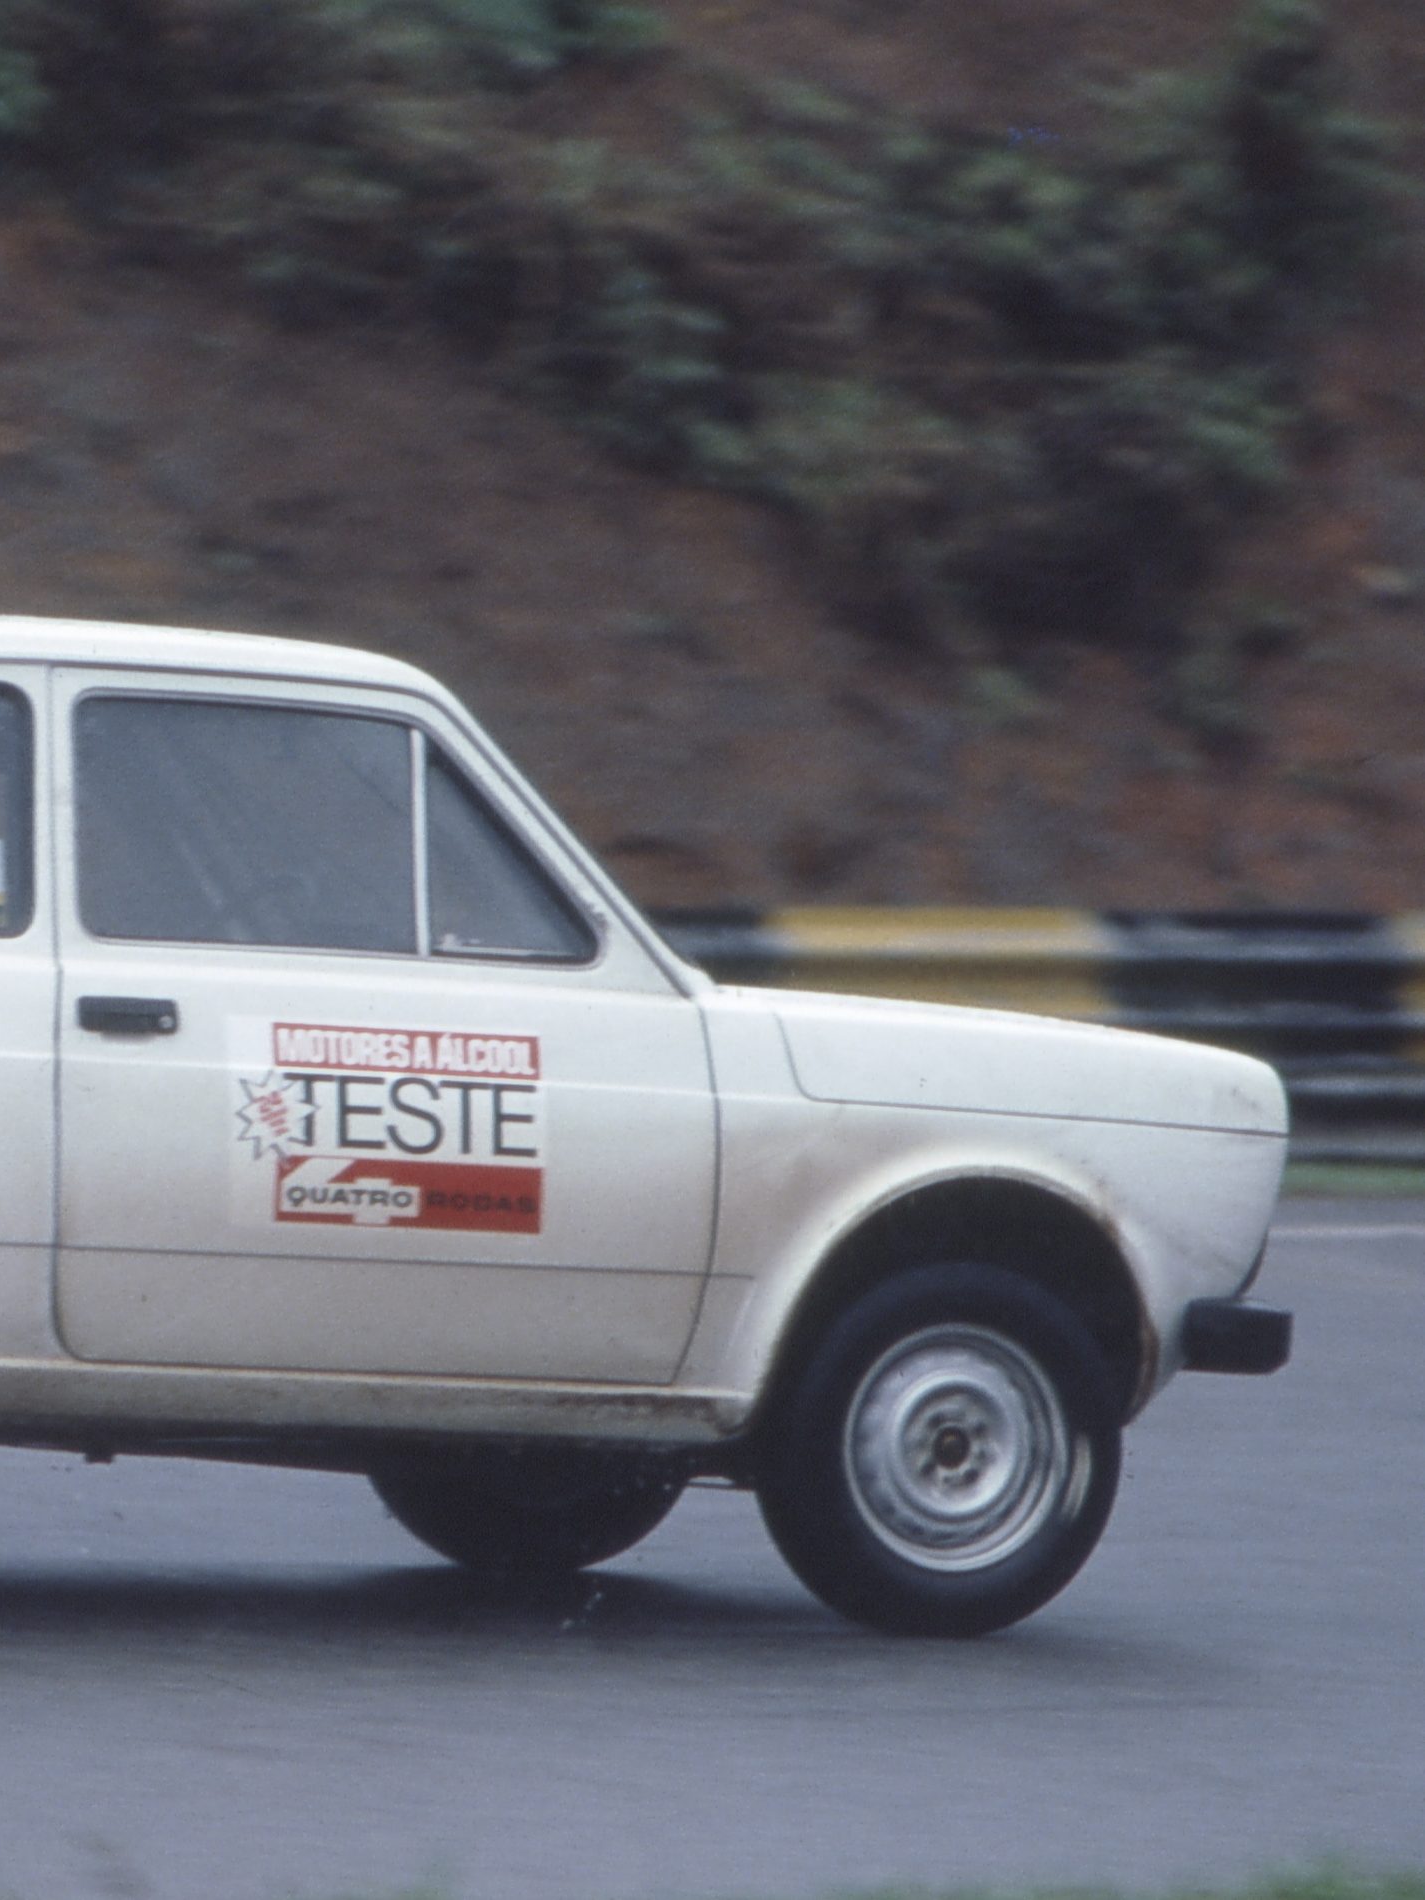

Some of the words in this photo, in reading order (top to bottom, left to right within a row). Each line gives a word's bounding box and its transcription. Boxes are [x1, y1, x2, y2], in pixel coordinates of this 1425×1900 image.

[276, 1027, 410, 1068] MOTORES
[413, 1035, 433, 1070] A
[436, 1033, 535, 1075] ÁLCOOL
[282, 1071, 538, 1157] TESTE
[286, 1186, 413, 1209] QUATRO
[426, 1190, 537, 1214] RODAS
